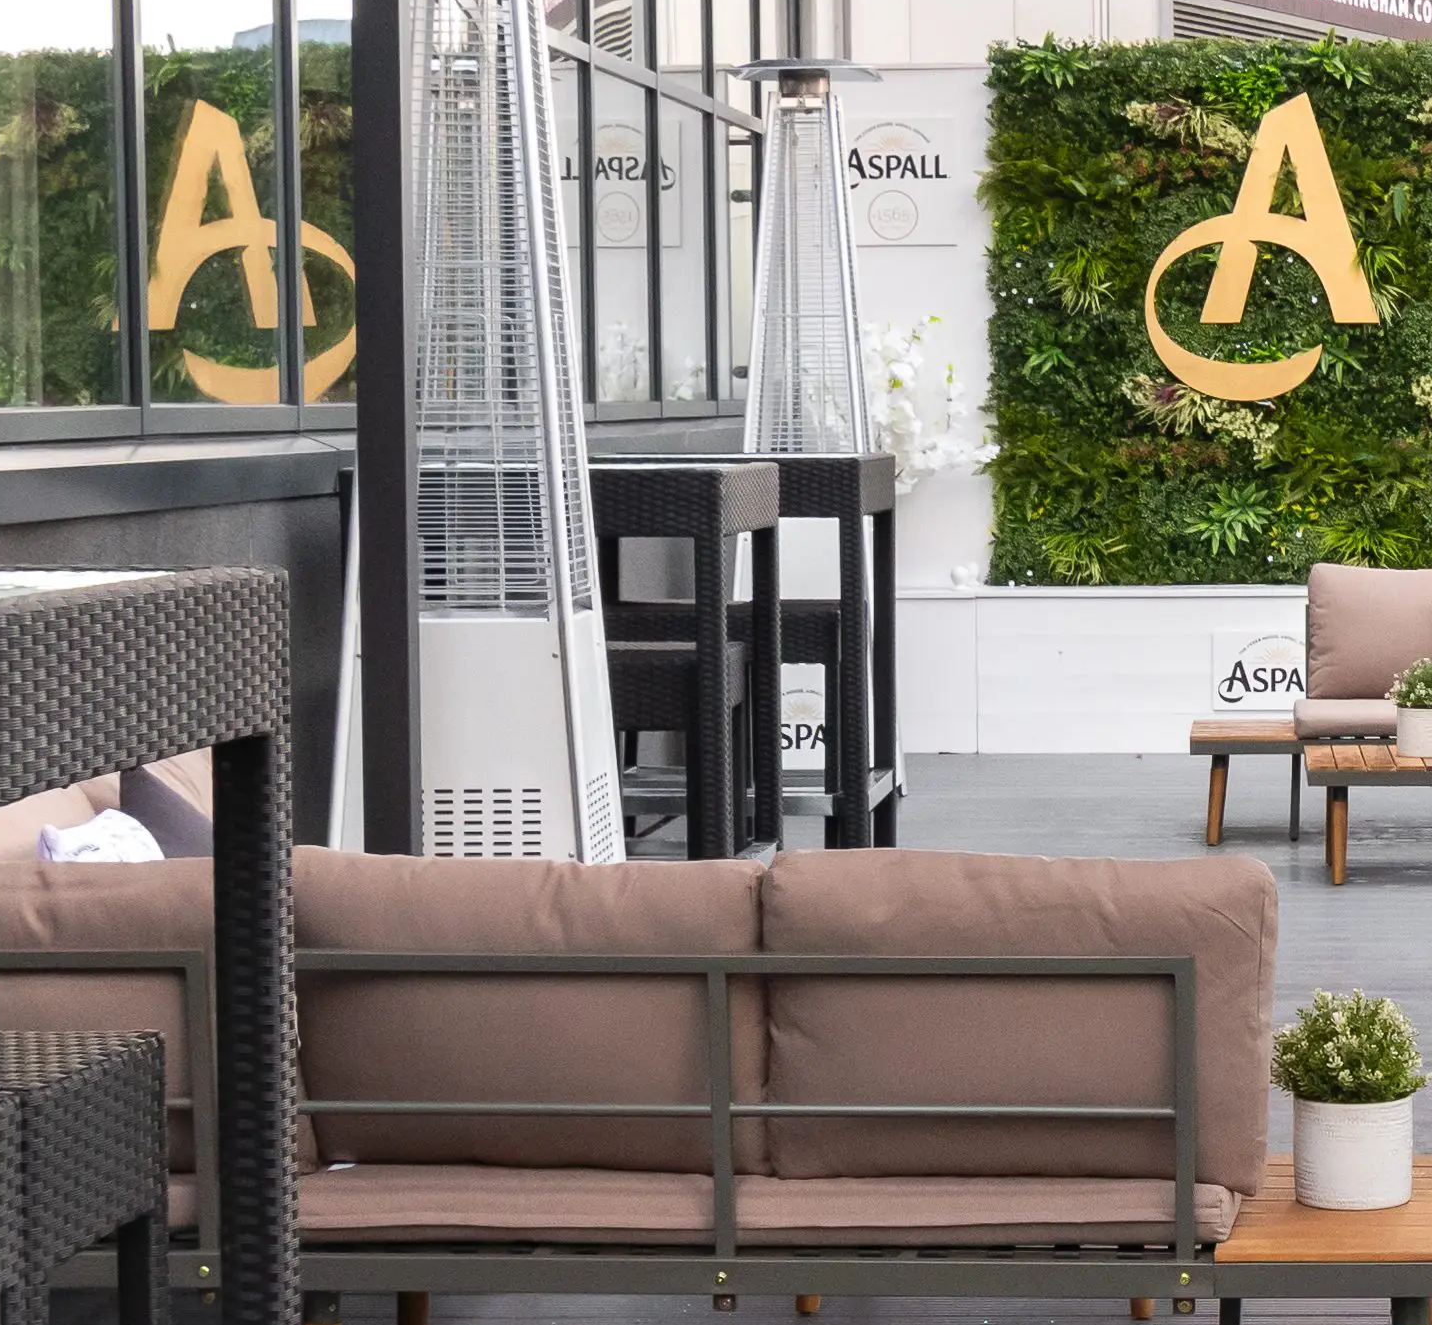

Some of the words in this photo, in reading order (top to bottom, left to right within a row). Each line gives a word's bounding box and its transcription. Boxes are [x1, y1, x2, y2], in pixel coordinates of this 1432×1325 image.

[848, 147, 948, 190] ASPALL
[1218, 660, 1304, 703] ASPA
[781, 723, 825, 750] SPA
